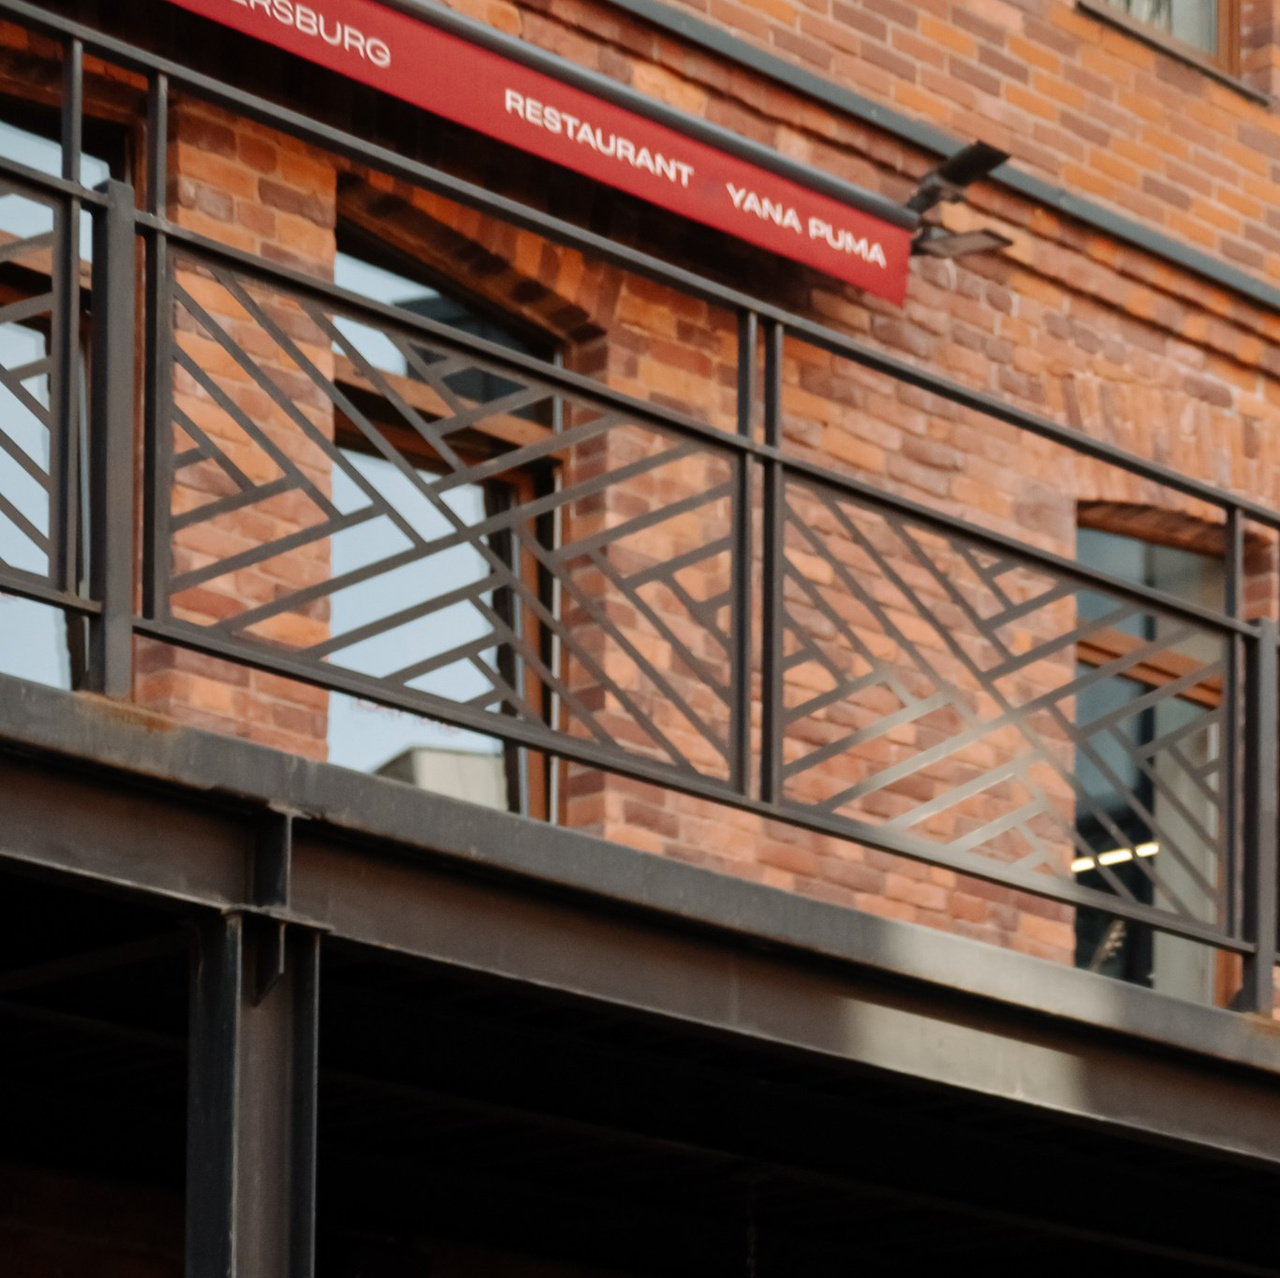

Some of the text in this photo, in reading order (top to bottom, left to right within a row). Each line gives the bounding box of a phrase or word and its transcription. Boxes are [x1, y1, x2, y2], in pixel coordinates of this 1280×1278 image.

[232, 0, 391, 67] RSBURG
[505, 88, 887, 270] RESTAURANT YANA PUMA
